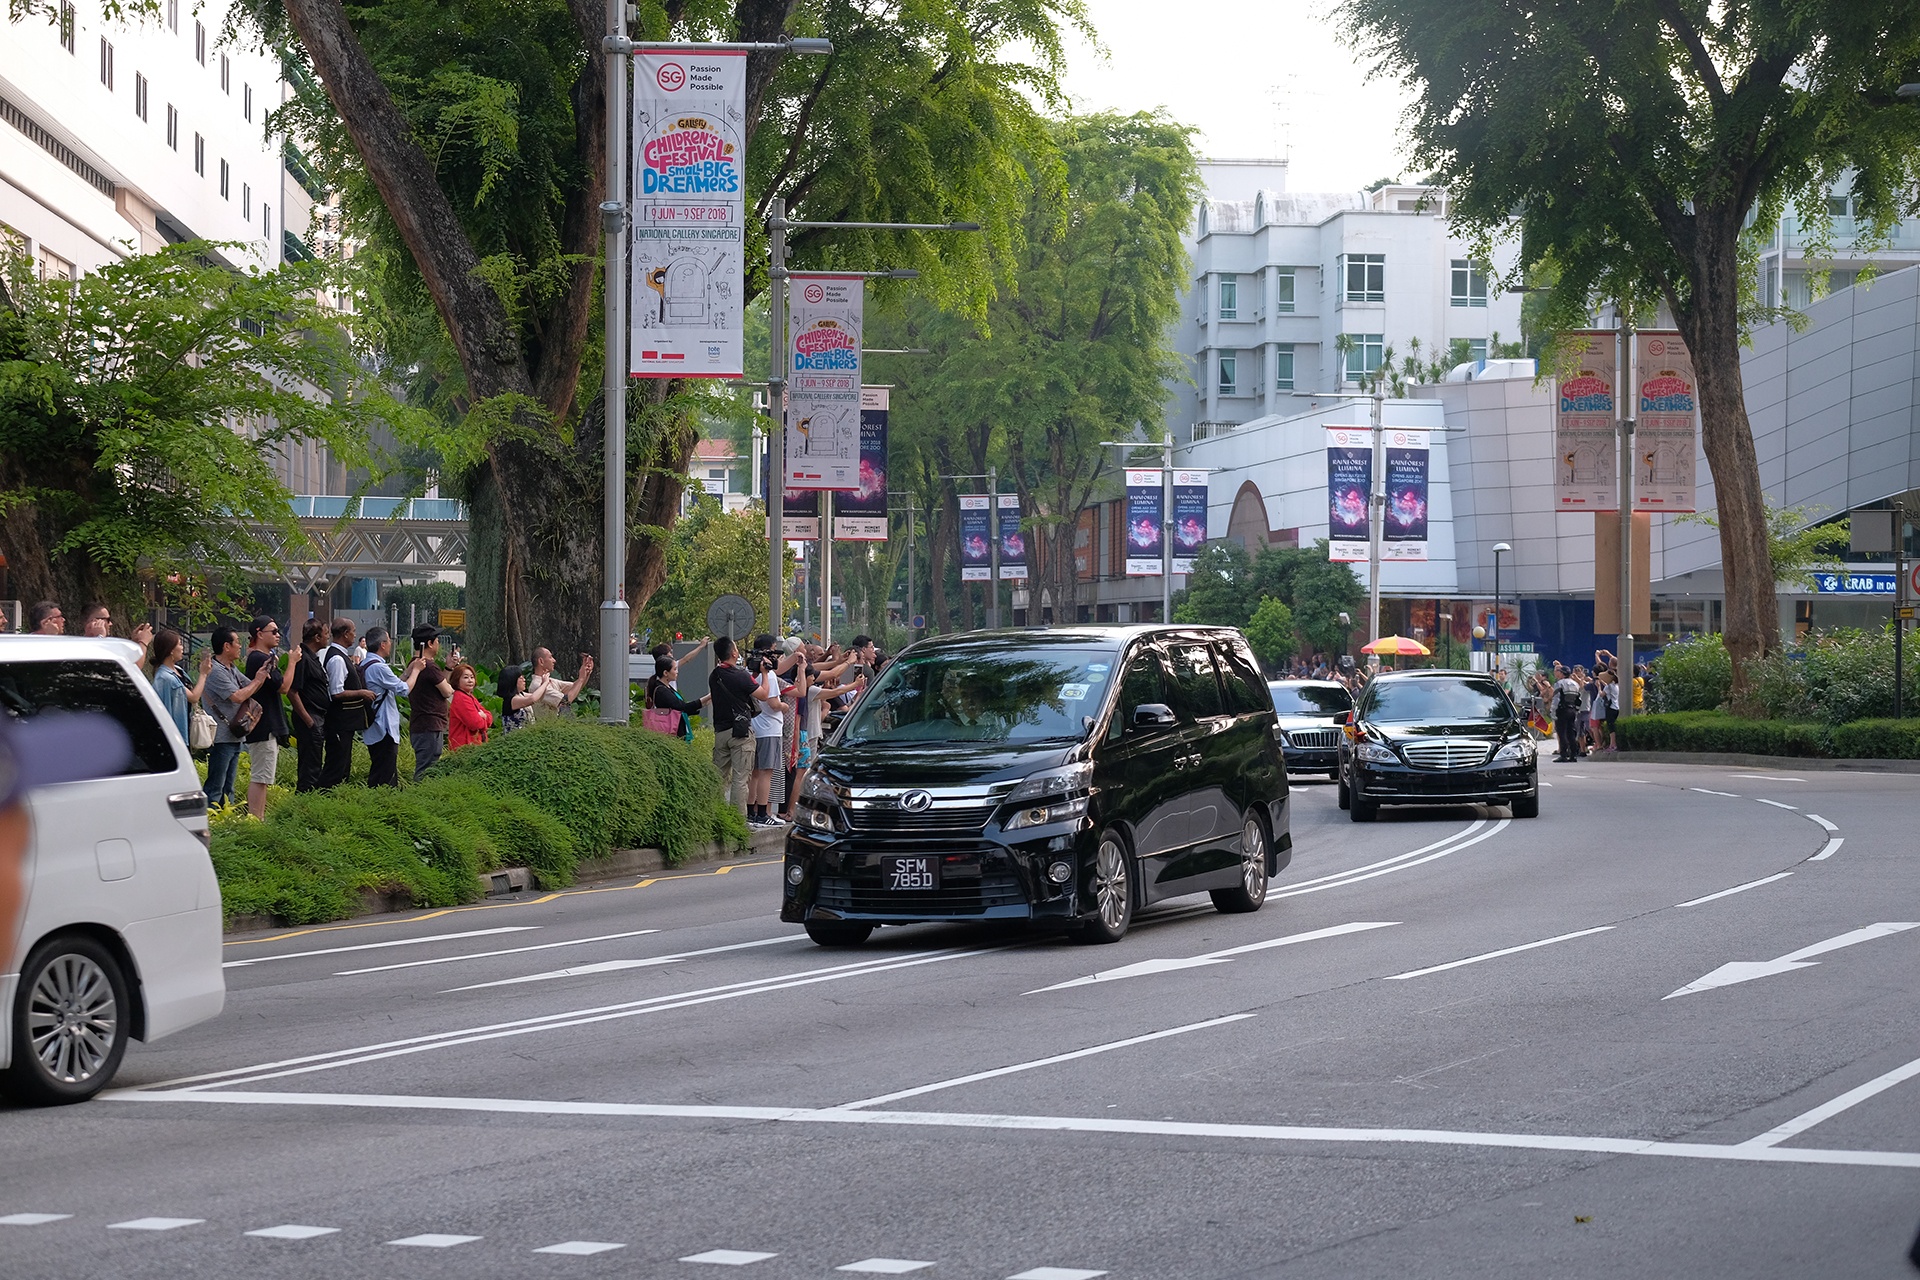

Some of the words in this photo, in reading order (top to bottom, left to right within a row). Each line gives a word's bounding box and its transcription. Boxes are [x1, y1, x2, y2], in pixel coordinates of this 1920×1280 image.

[661, 71, 682, 84] SG
[660, 138, 734, 174] FESTIVAL
[704, 161, 734, 177] BIG
[651, 208, 657, 219] 9
[658, 208, 675, 220] JUN
[684, 208, 689, 220] 9
[691, 208, 705, 220] SEP
[708, 208, 726, 220] 2018
[640, 229, 670, 238] NATIONAL
[672, 229, 700, 238] GALLERY
[701, 229, 737, 239] SINGAPORE
[807, 290, 821, 298] SG
[806, 334, 854, 357] FESTIVAL
[834, 349, 854, 359] BIG
[837, 379, 850, 387] 2018
[1570, 382, 1610, 401] FESTIVAL
[1650, 382, 1690, 401] FESTIVAL
[1594, 394, 1610, 403] BIG
[1674, 394, 1691, 402] BIG
[1845, 578, 1873, 590] CRAB
[1876, 582, 1884, 590] IN
[896, 859, 926, 872] SFM
[890, 873, 932, 887] 785D
